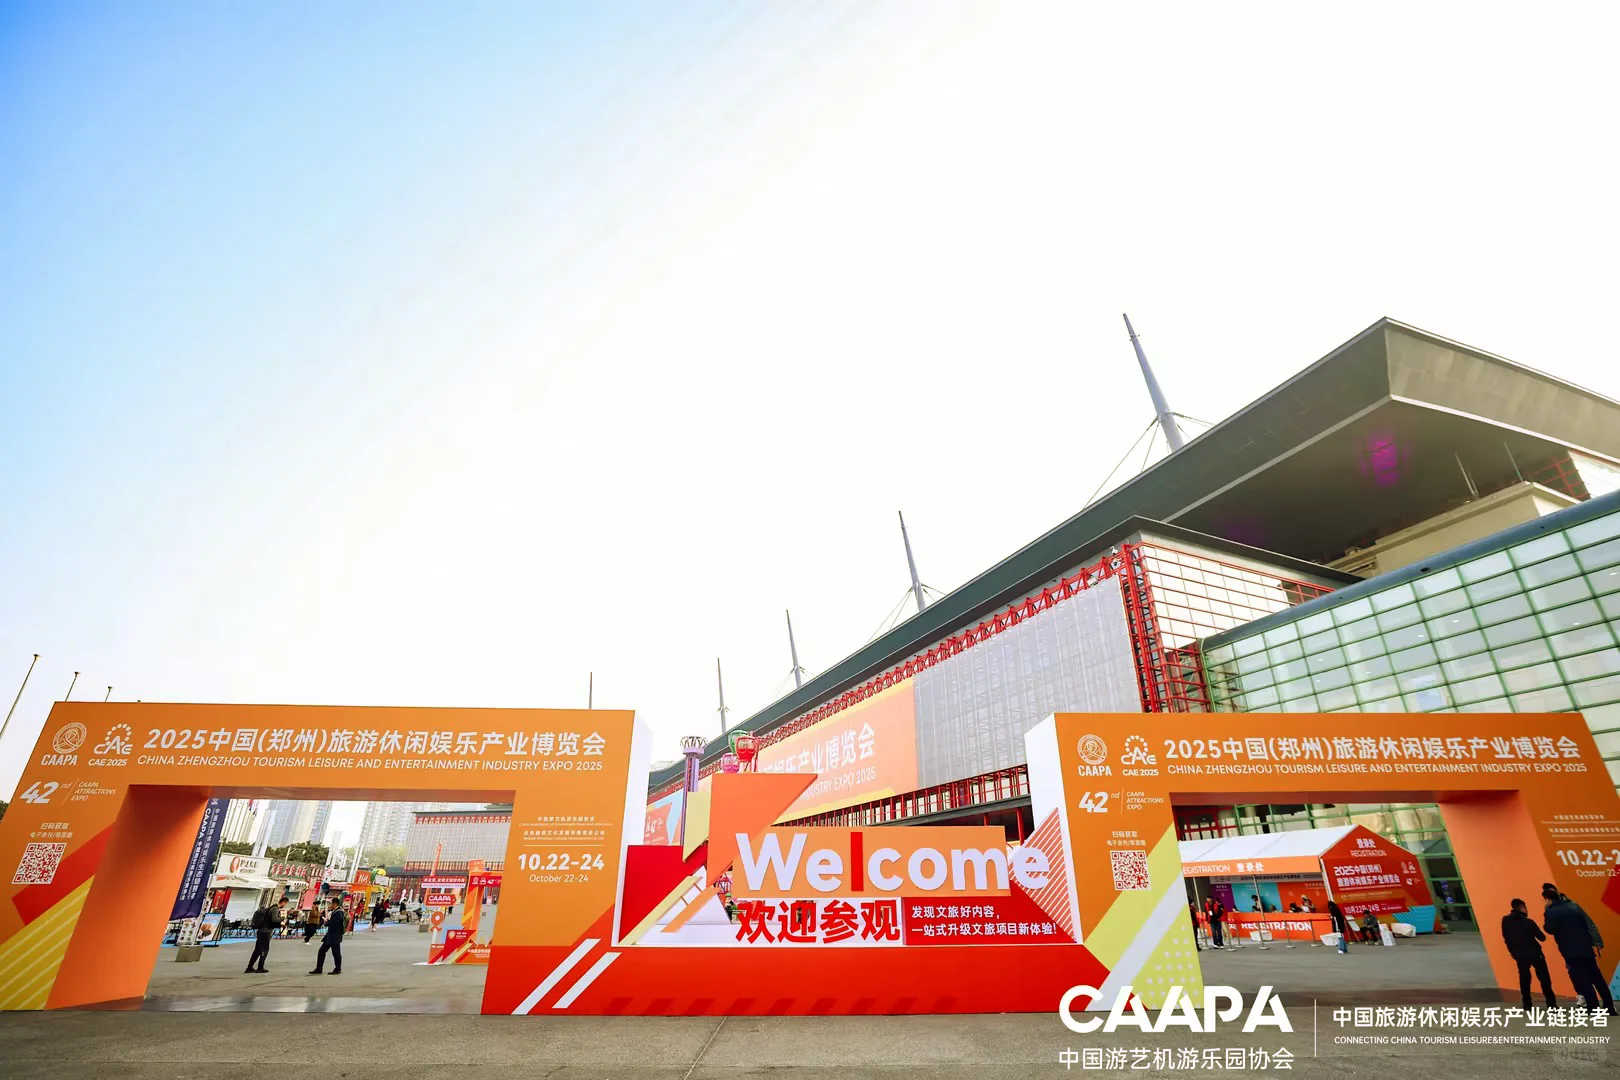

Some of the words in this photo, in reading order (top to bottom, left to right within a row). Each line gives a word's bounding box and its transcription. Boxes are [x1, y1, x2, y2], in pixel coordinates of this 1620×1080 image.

[143, 727, 606, 757] 2025中国(郑州)旅游休闲娱乐产业博览会
[764, 722, 875, 774] 乐产业博览会
[1164, 736, 1581, 761] 2025中国(郑州)旅游休闲娱乐产业博览会
[40, 754, 79, 766] CAAPA
[88, 758, 106, 767] CAE
[107, 758, 129, 767] 2025
[137, 755, 175, 765] CHINA
[177, 755, 251, 767] ZHENGZHOU
[252, 757, 306, 768] TOURISM
[308, 757, 354, 768] LEISURE
[355, 758, 382, 769] AND
[384, 758, 481, 770] ENTERTAINMENT
[481, 760, 541, 771] INDUSTRY
[542, 760, 573, 771] EXPO
[575, 761, 603, 771] 2025
[1078, 765, 1113, 777] CAAPA
[1122, 768, 1139, 776] CAE
[1140, 768, 1160, 776] 2025
[1167, 764, 1203, 774] CHINA
[1205, 764, 1273, 774] ZHENGZHOU
[1274, 764, 1324, 774] TOURISM
[1325, 764, 1368, 774] LEISURE
[1369, 763, 1393, 773] AND
[1395, 763, 1479, 773] ENTERTAINMENT
[1480, 763, 1531, 773] INDUSTRY
[1535, 763, 1561, 773] EXPO
[1564, 763, 1588, 773] 2025
[834, 772, 855, 790] EXPO
[856, 766, 876, 784] 2025
[518, 853, 605, 871] 10.22-24
[735, 831, 1050, 893] Welcome
[1556, 849, 1620, 866] 10.22-2
[1182, 864, 1231, 875] EGISTRATION
[1576, 869, 1606, 878] October
[1606, 869, 1620, 877] 22-
[529, 873, 562, 883] October
[564, 873, 589, 883] 22-24
[735, 899, 900, 944] 欢迎参观
